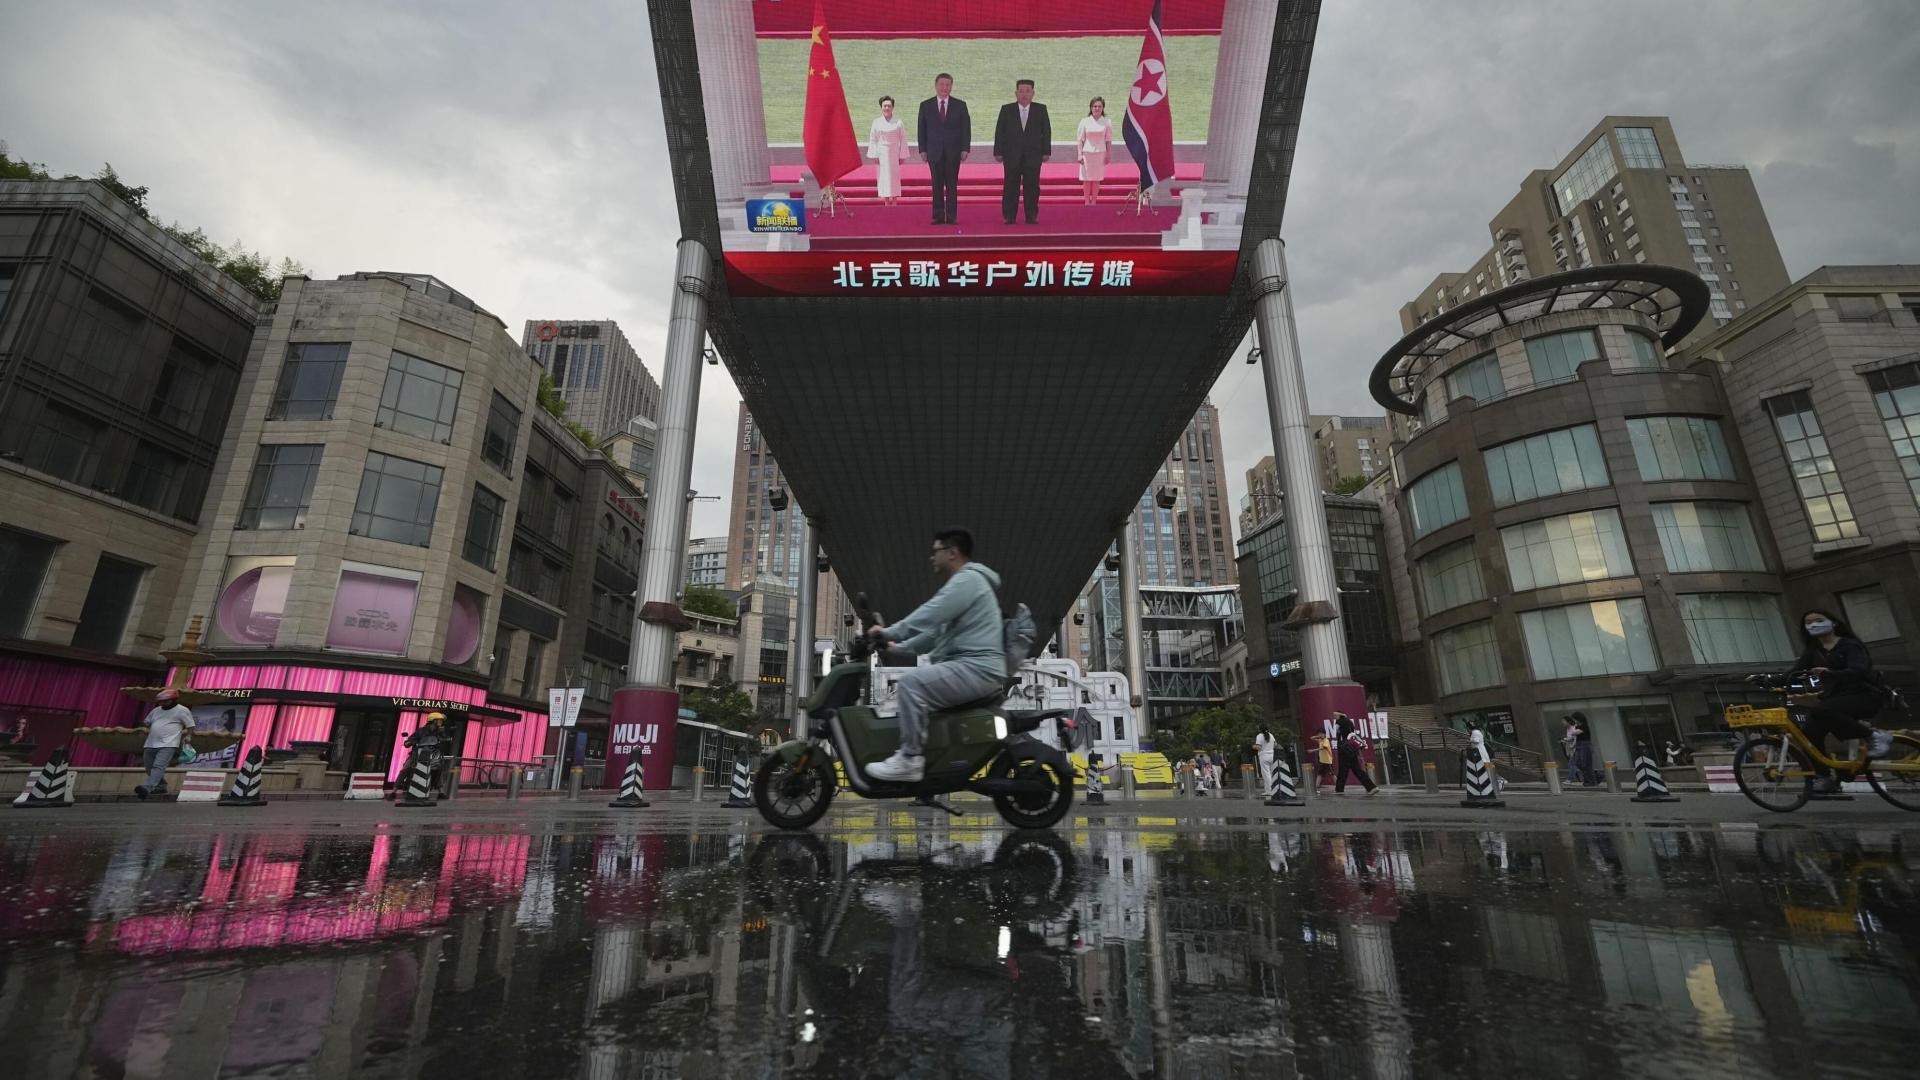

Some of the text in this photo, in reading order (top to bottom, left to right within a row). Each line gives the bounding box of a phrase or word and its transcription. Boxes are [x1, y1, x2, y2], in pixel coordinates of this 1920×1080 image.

[756, 216, 798, 226] 新闻联播
[832, 260, 1135, 287] 北京歌华户外传媒
[1009, 684, 1045, 699] ACE
[393, 697, 469, 712] VICTORIA'S SECRET
[613, 723, 659, 743] MUJI
[1323, 718, 1369, 739] MJI
[614, 745, 652, 755] 無印品
